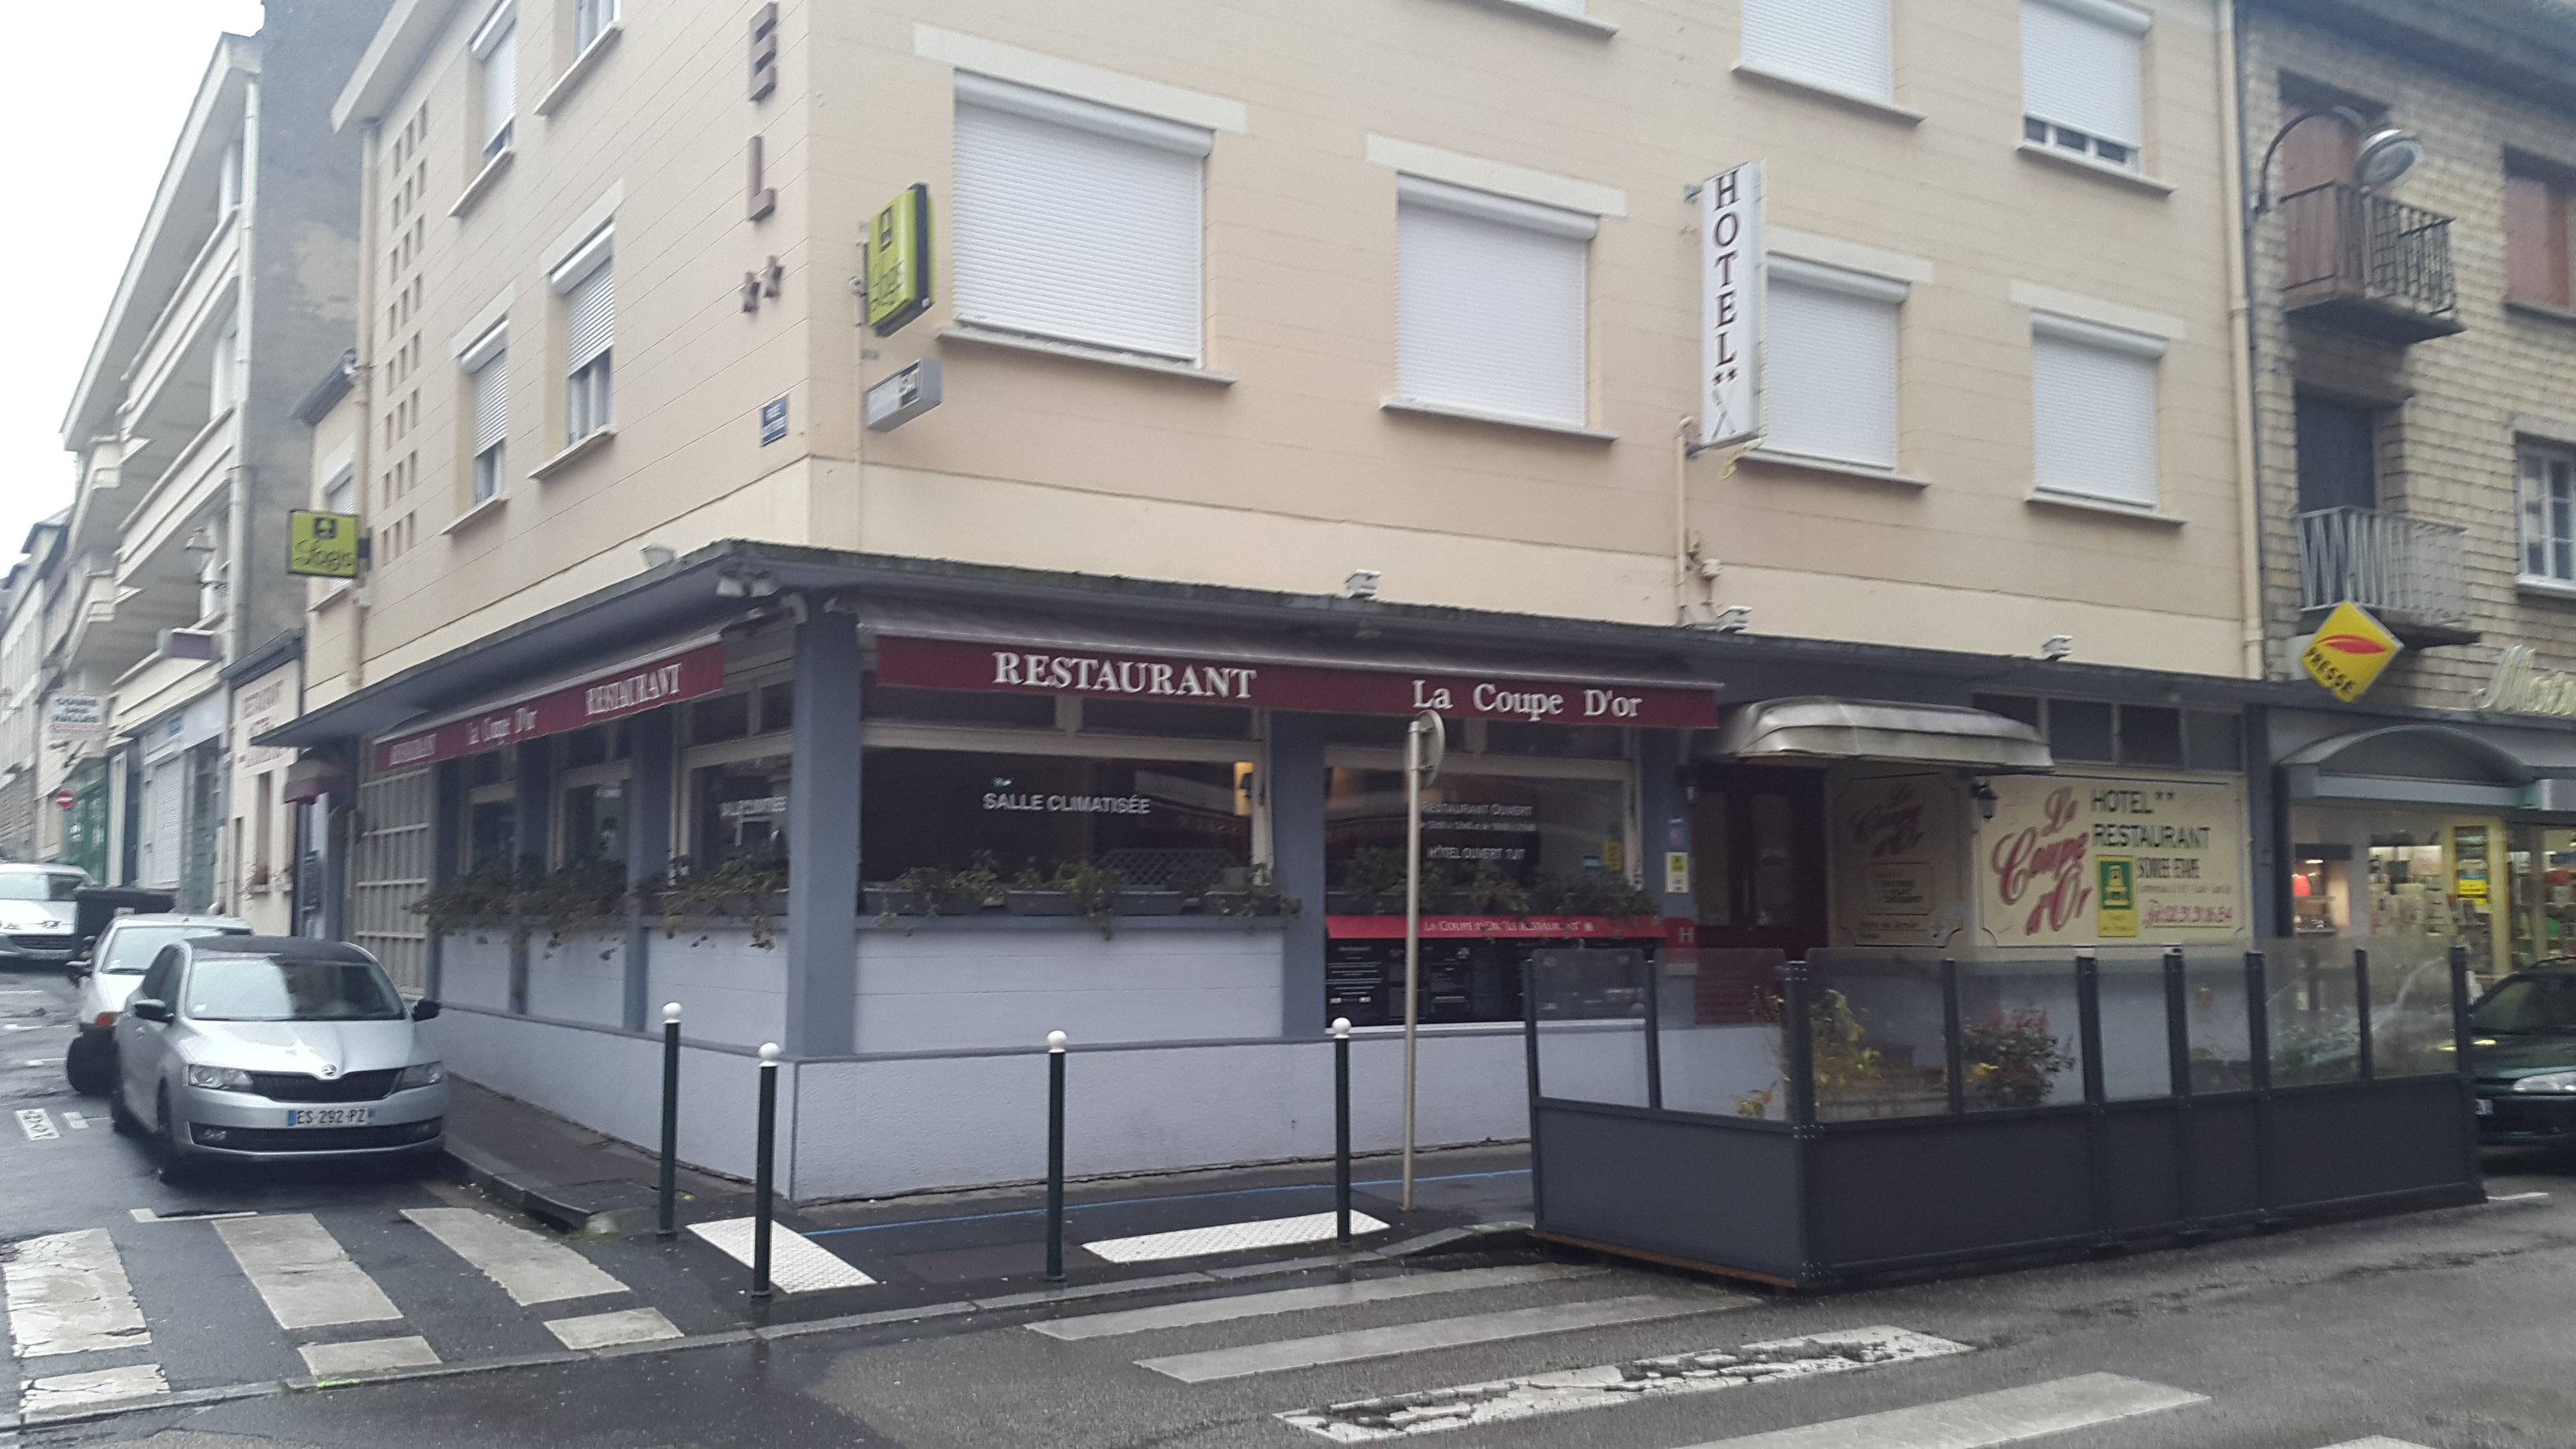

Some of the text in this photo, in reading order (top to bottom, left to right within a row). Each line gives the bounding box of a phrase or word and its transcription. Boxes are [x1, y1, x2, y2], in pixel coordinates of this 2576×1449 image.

[1712, 168, 1742, 367] HOTEL
[585, 663, 683, 717] RESTAURANT
[991, 650, 1258, 700] RESTAURANT
[2305, 646, 2357, 695] PRESSE
[1412, 680, 1454, 710] La
[1472, 683, 1565, 721] Coupe
[983, 792, 1151, 814] SALLE CLIMATISÉE
[2091, 822, 2211, 849] RESTAURANT
[297, 1108, 366, 1125] ES-292-PZ
